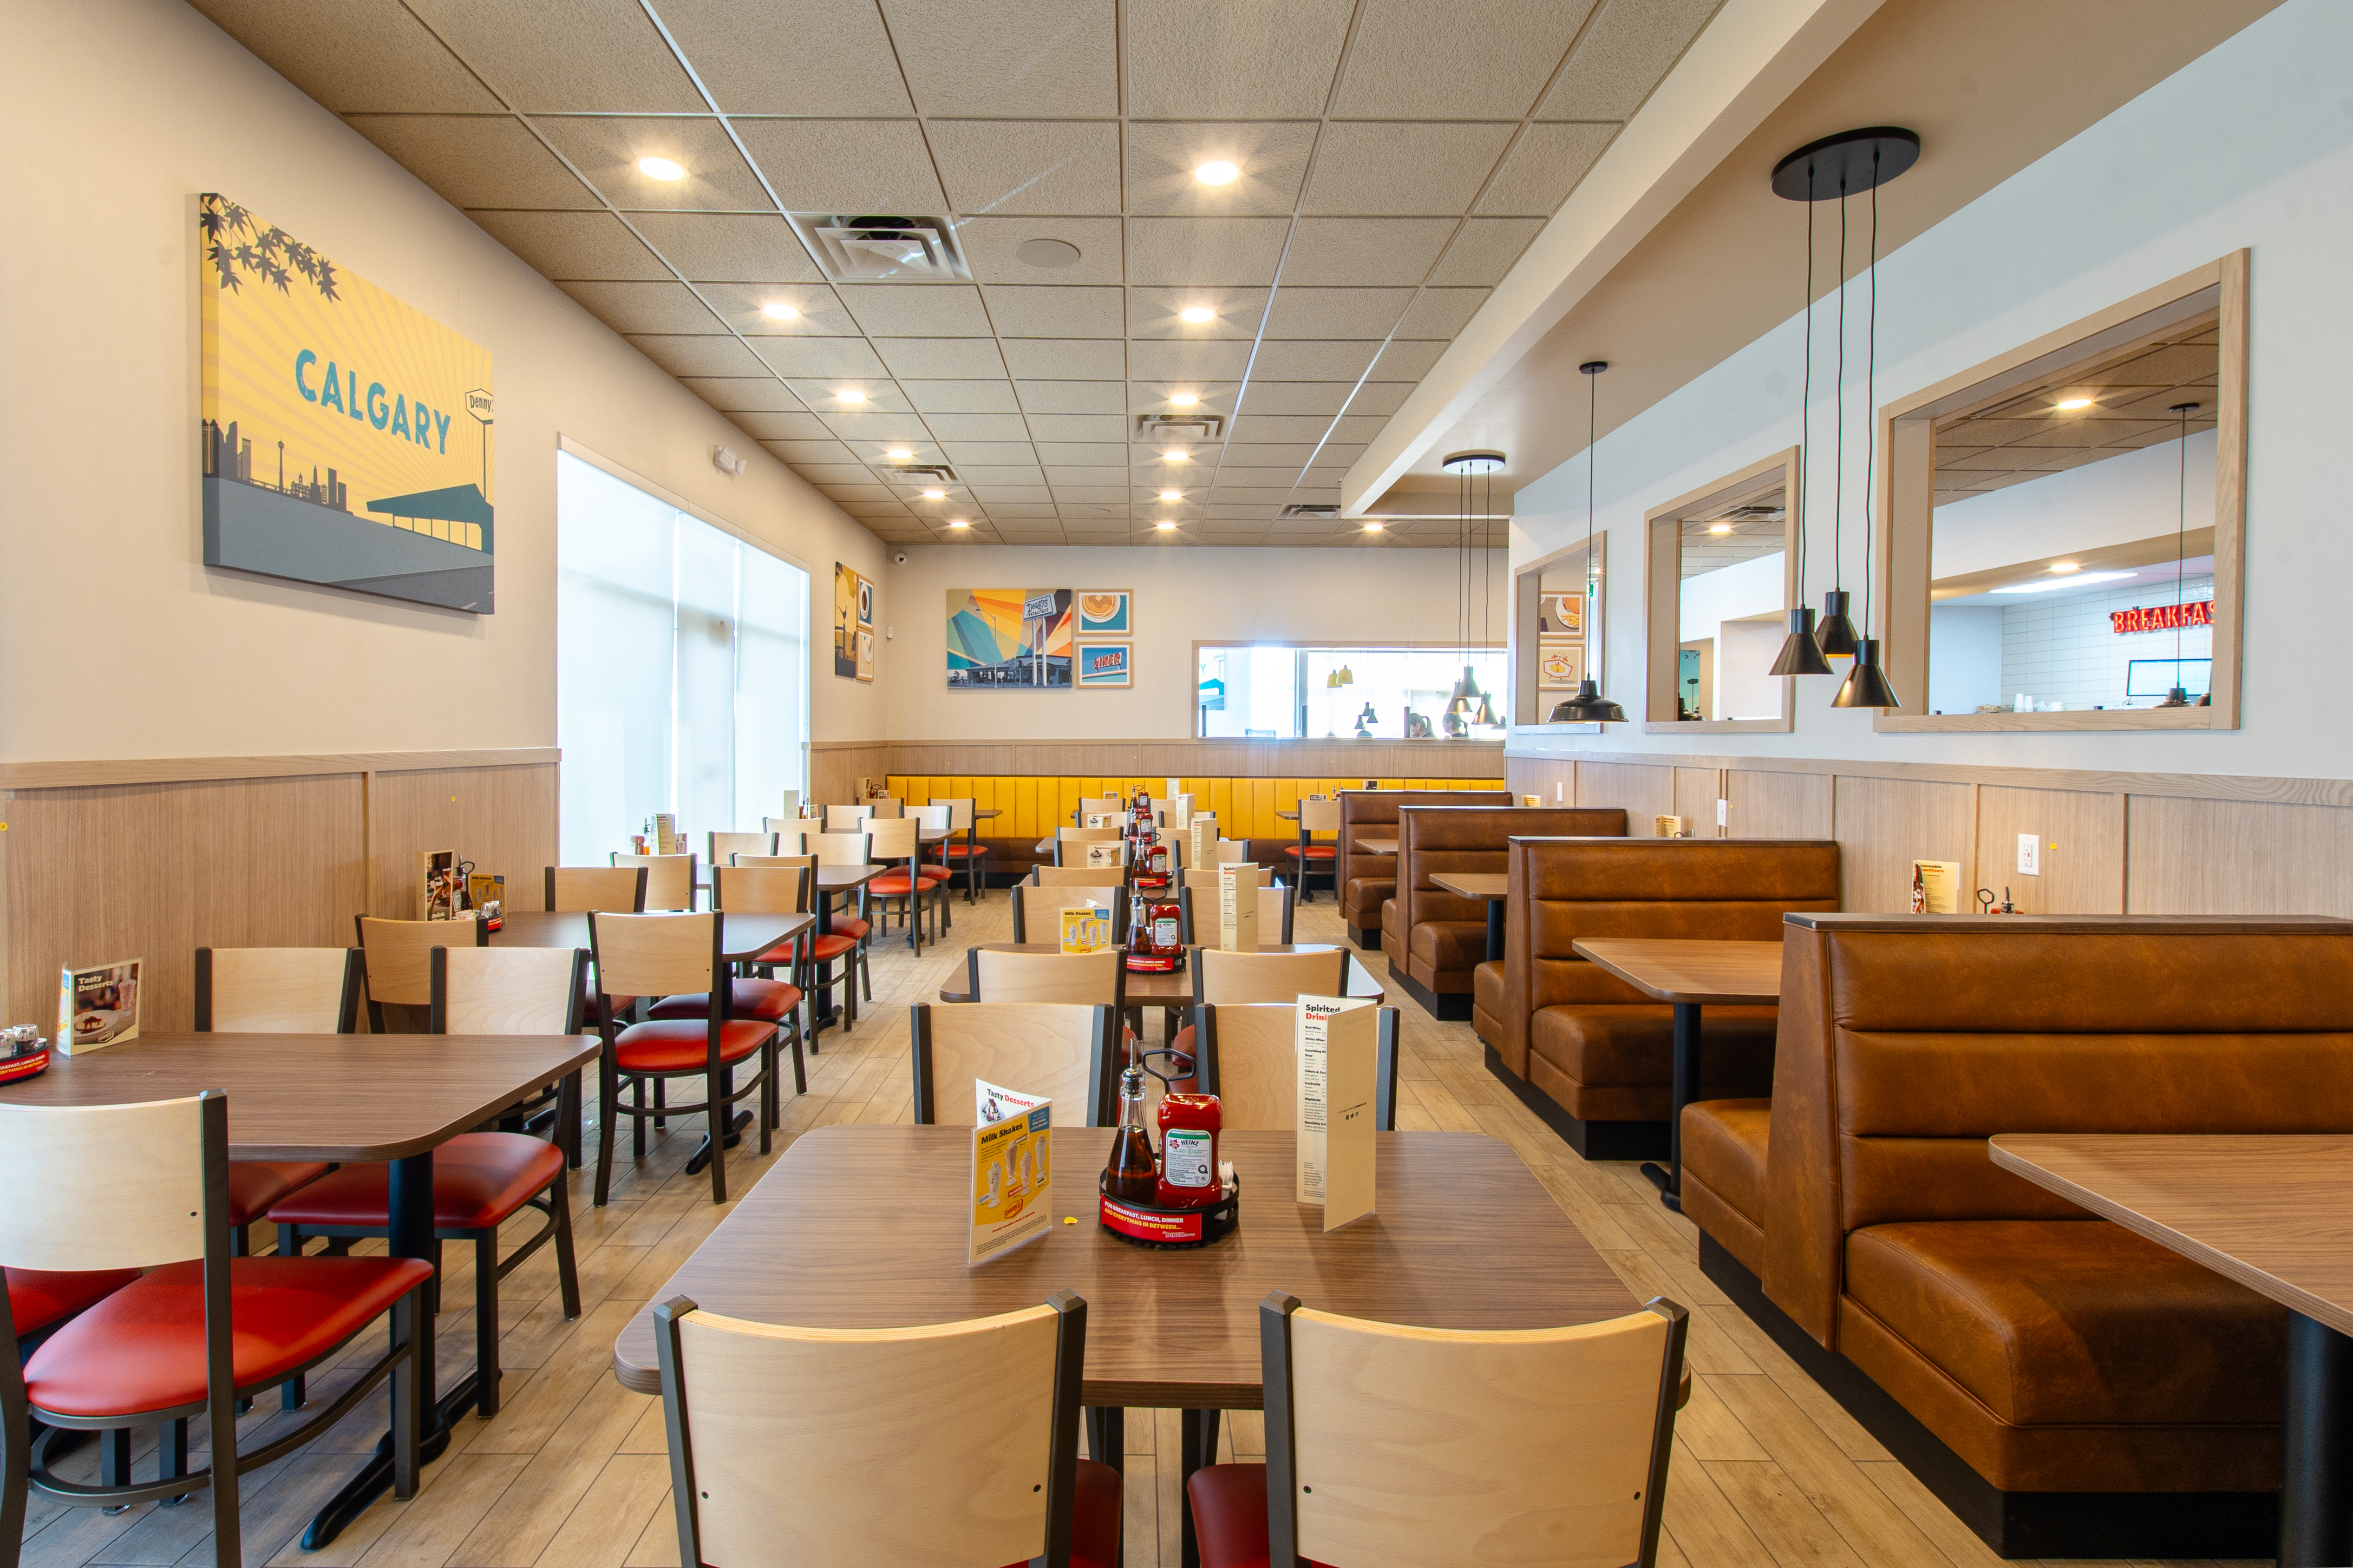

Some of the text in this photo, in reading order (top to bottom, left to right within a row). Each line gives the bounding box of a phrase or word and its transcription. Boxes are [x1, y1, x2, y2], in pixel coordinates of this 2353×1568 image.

[296, 349, 451, 455] CALGARY
[1026, 598, 1049, 613] Denny's
[1027, 607, 1049, 617] restaurant
[1094, 652, 1121, 669] DINER
[79, 975, 102, 985] Tasty
[79, 980, 114, 992] Desserts
[1305, 1004, 1341, 1013] Spirited
[987, 1088, 1035, 1107] Tasty Desserts
[981, 1123, 1023, 1145] Milk Shakes
[1104, 1200, 1113, 1209] FOR
[1113, 1205, 1140, 1219] BREAKFAST,
[1140, 1214, 1161, 1223] LUNCH,
[1104, 1208, 1113, 1216] AND
[1113, 1211, 1142, 1226] EVERYTHING
